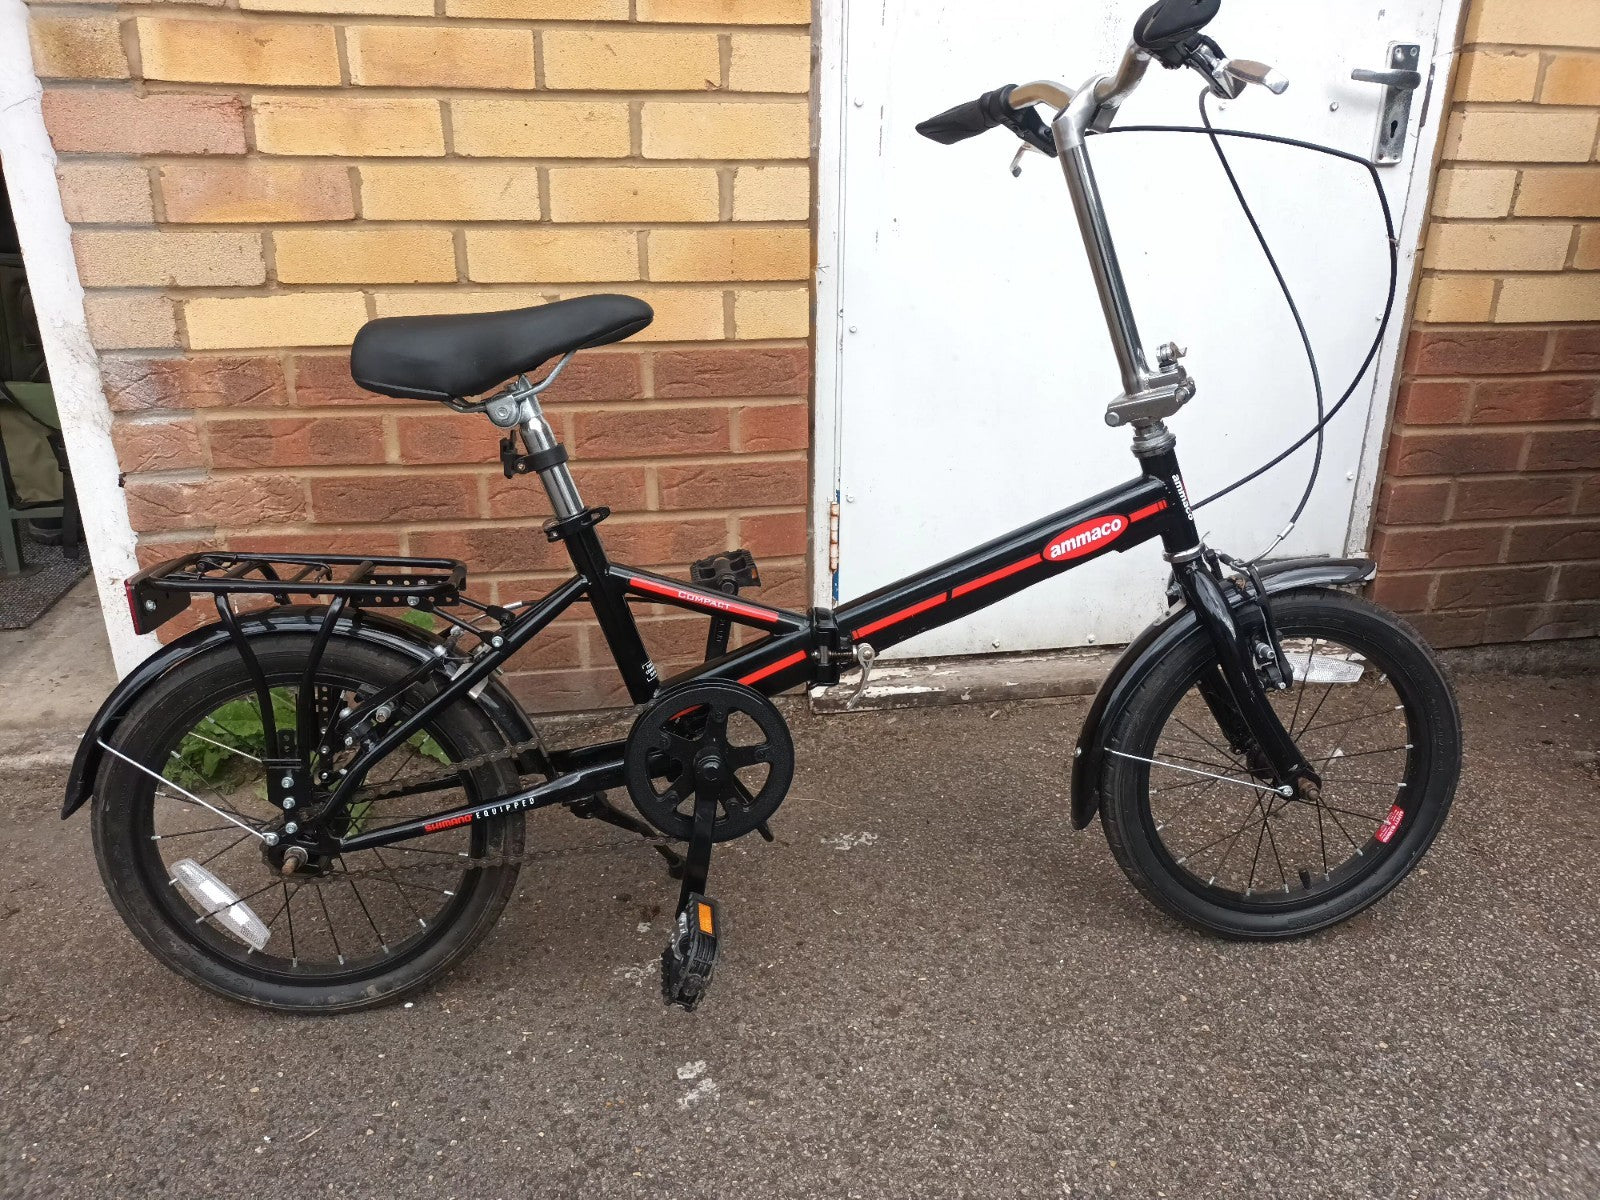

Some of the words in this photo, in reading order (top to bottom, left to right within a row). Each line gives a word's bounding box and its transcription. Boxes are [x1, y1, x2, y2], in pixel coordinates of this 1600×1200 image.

[1172, 474, 1194, 520] ammaco
[1050, 519, 1122, 558] ammaco
[678, 591, 731, 610] COMPACT
[424, 814, 473, 832] SHIMANO
[475, 798, 534, 819] EQUIPPED
